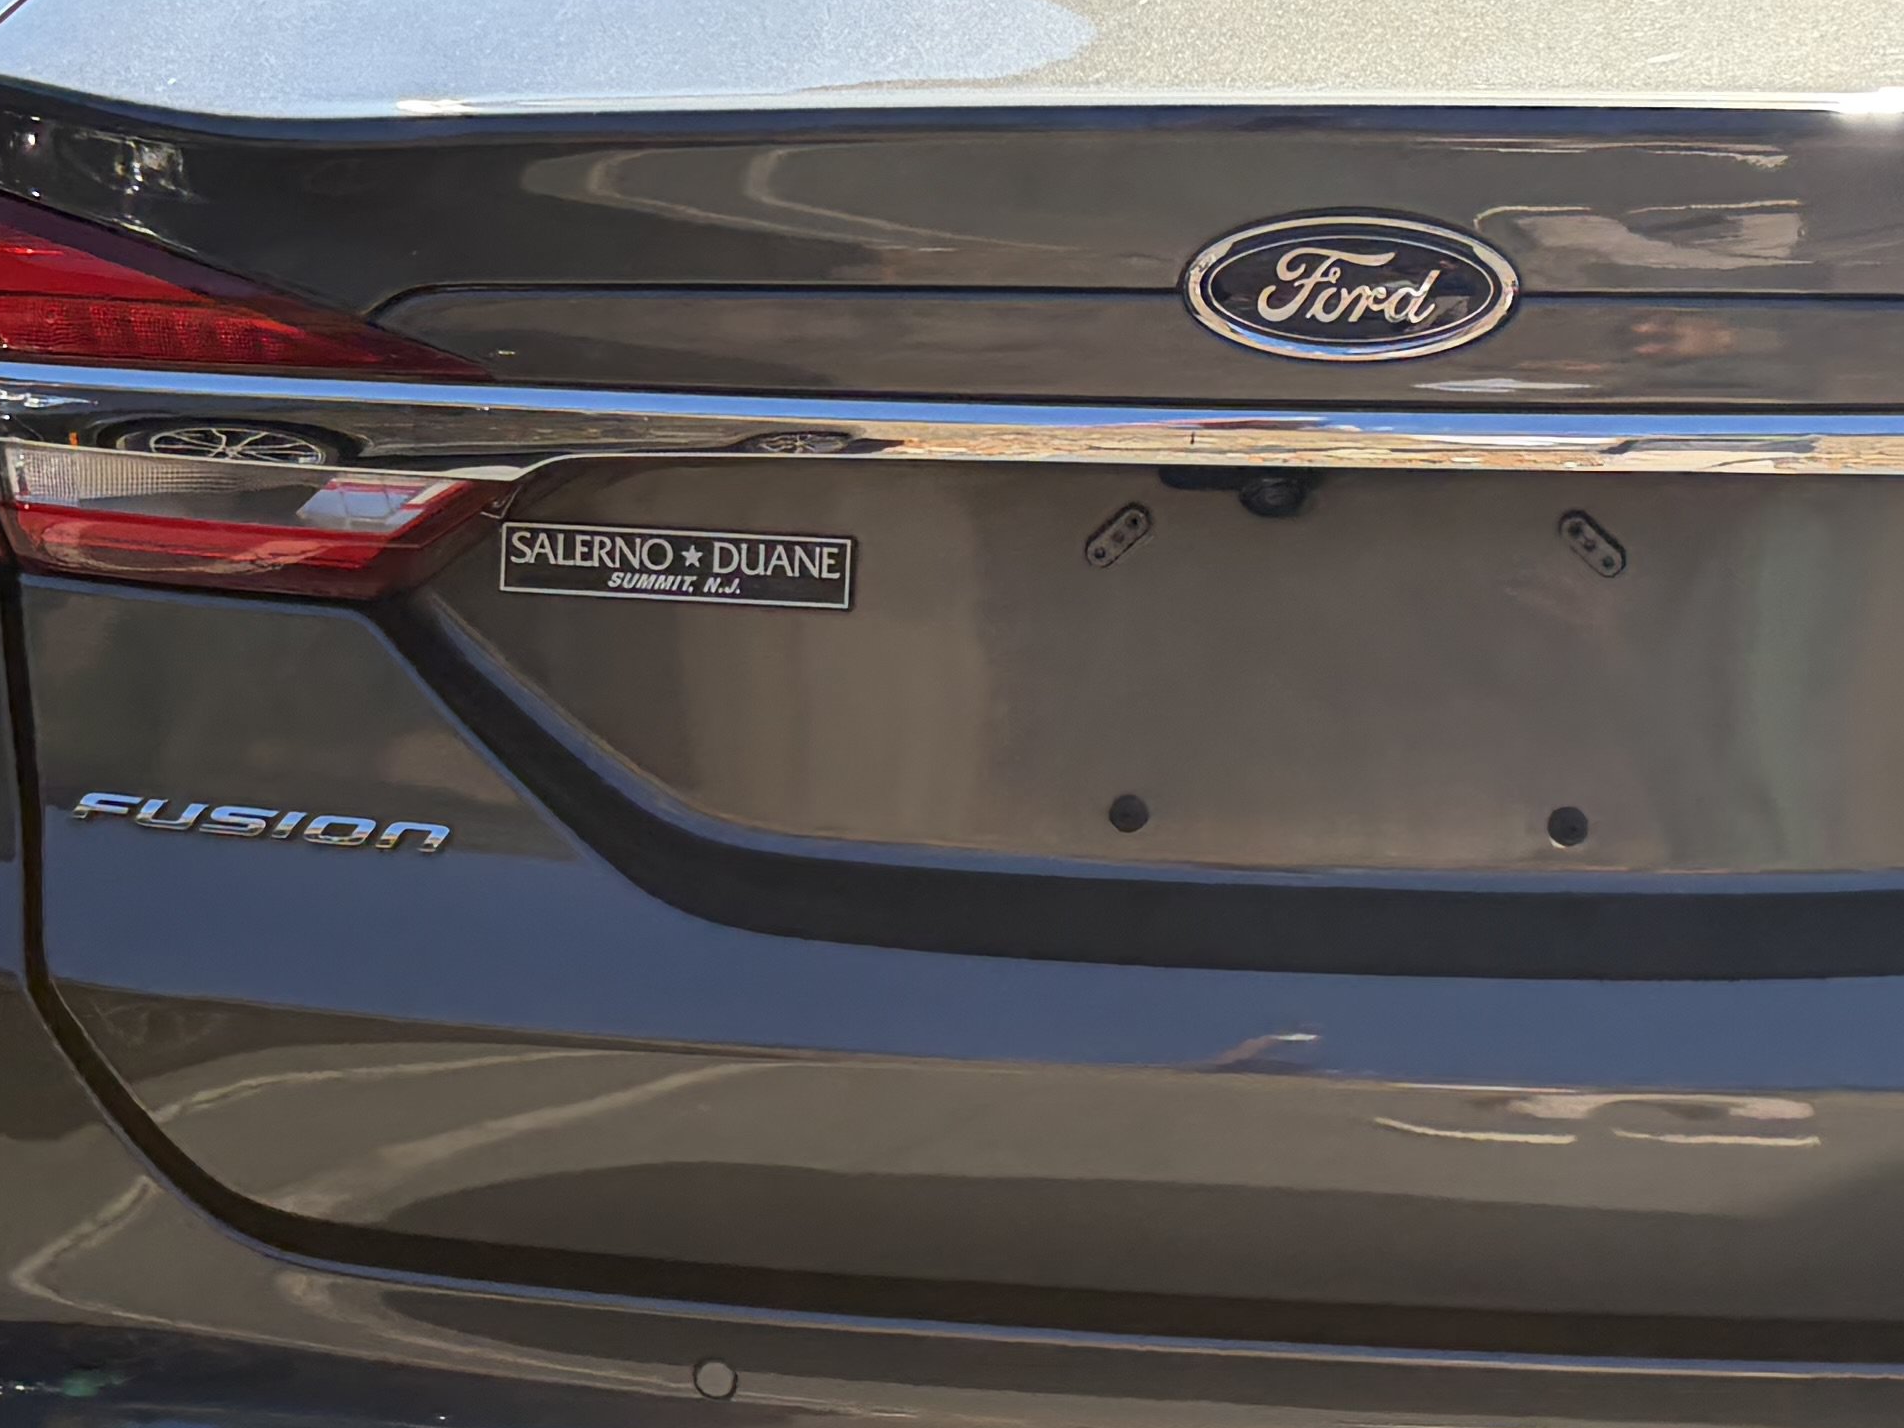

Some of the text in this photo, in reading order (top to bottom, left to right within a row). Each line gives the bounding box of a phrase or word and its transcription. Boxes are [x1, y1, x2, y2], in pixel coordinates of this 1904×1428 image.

[1257, 246, 1441, 324] Ford
[509, 531, 842, 580] SALERNO DUANE
[703, 576, 742, 595] N.J.
[72, 791, 451, 854] FUSION
